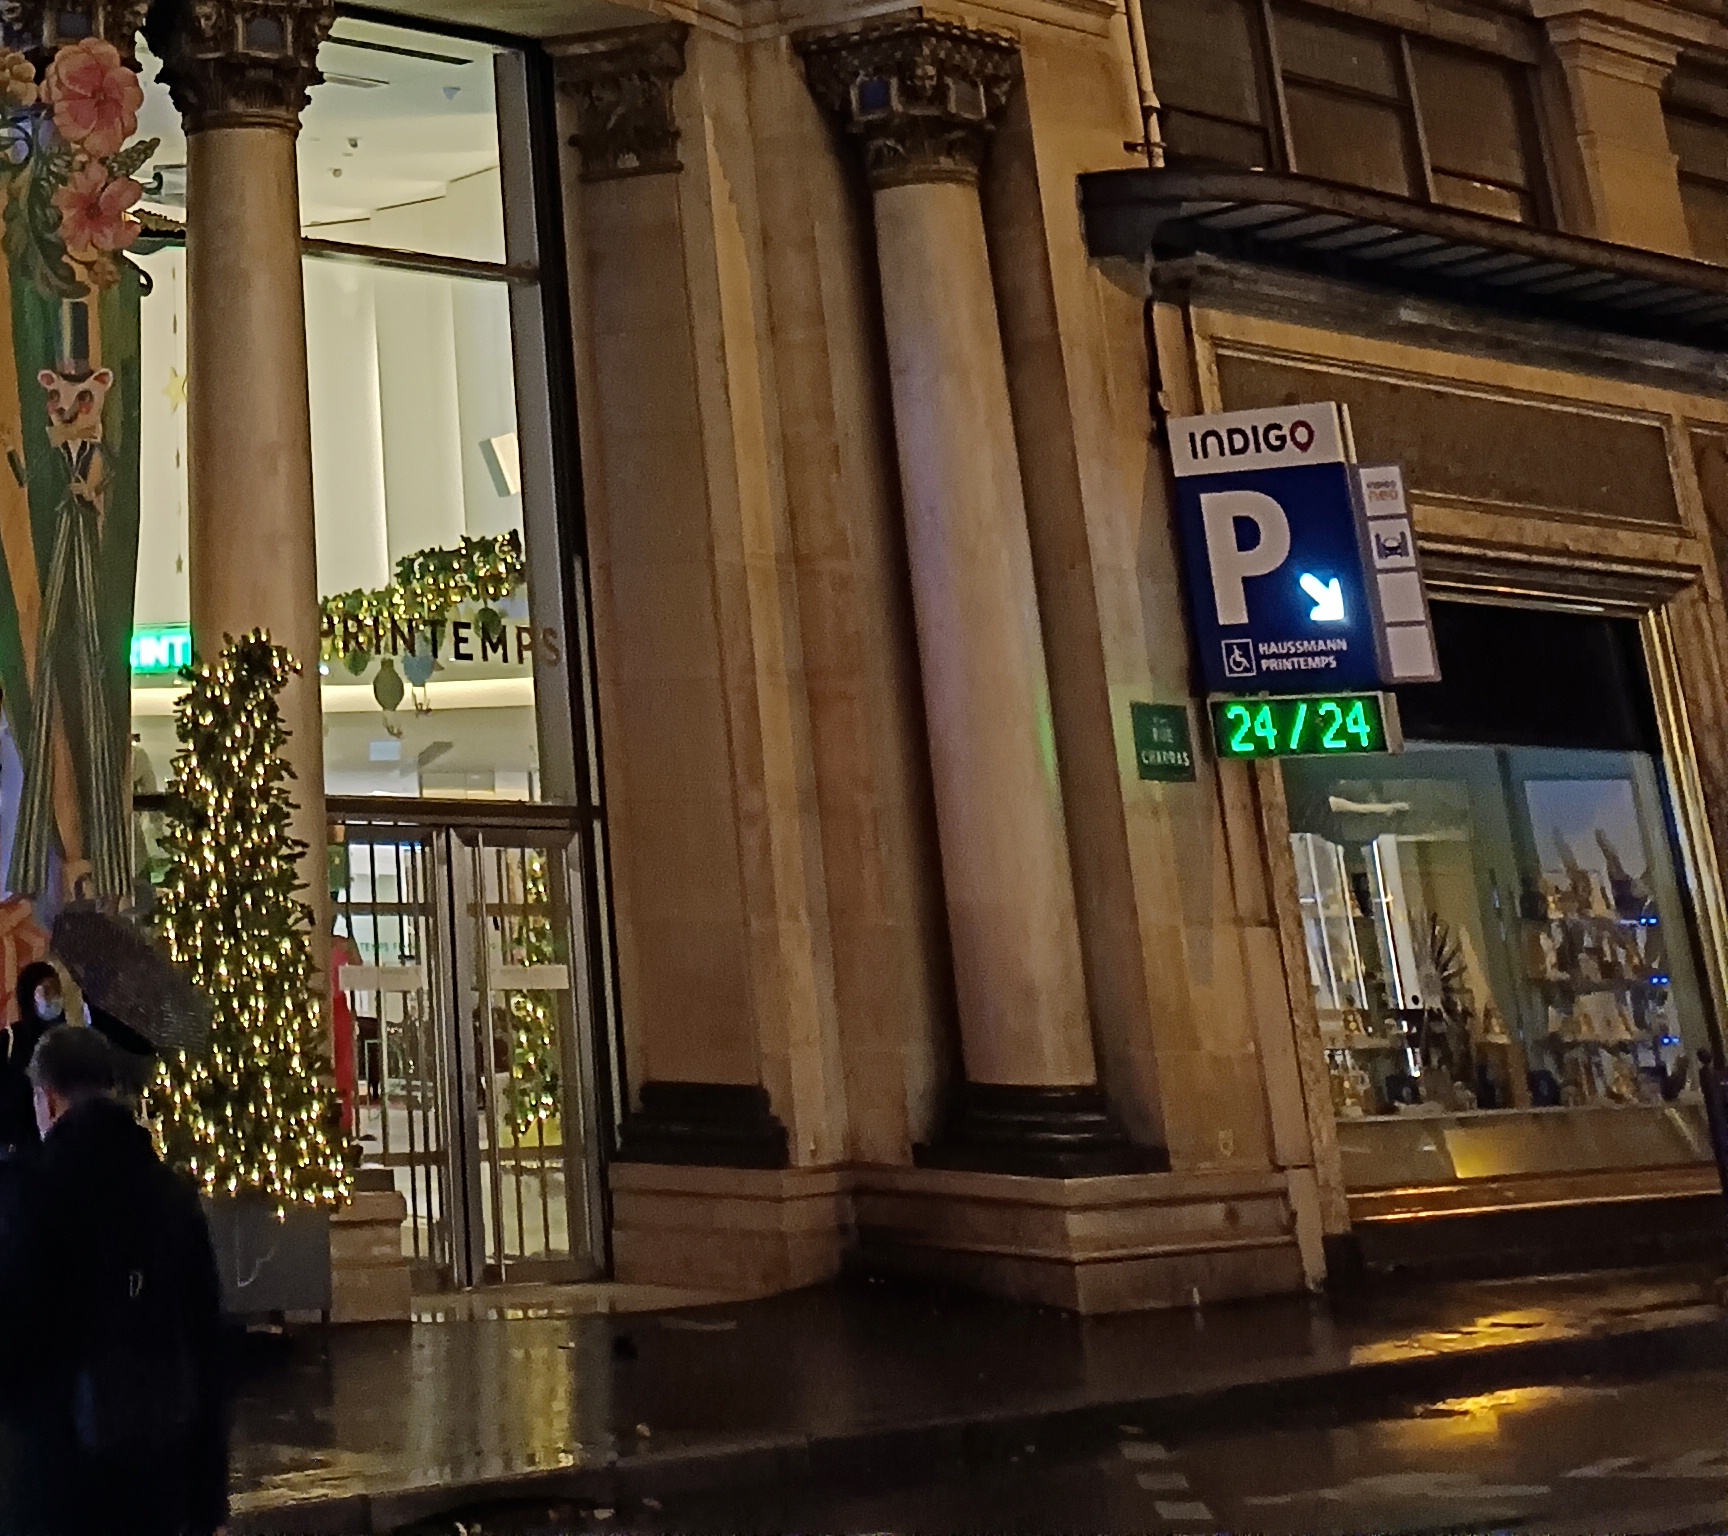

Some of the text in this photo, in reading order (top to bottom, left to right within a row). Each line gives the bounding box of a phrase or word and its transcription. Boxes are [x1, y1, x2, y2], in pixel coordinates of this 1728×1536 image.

[1199, 489, 1291, 626] P
[1258, 638, 1348, 655] HAUSSMANN
[1260, 655, 1337, 672] PRINTEMPS
